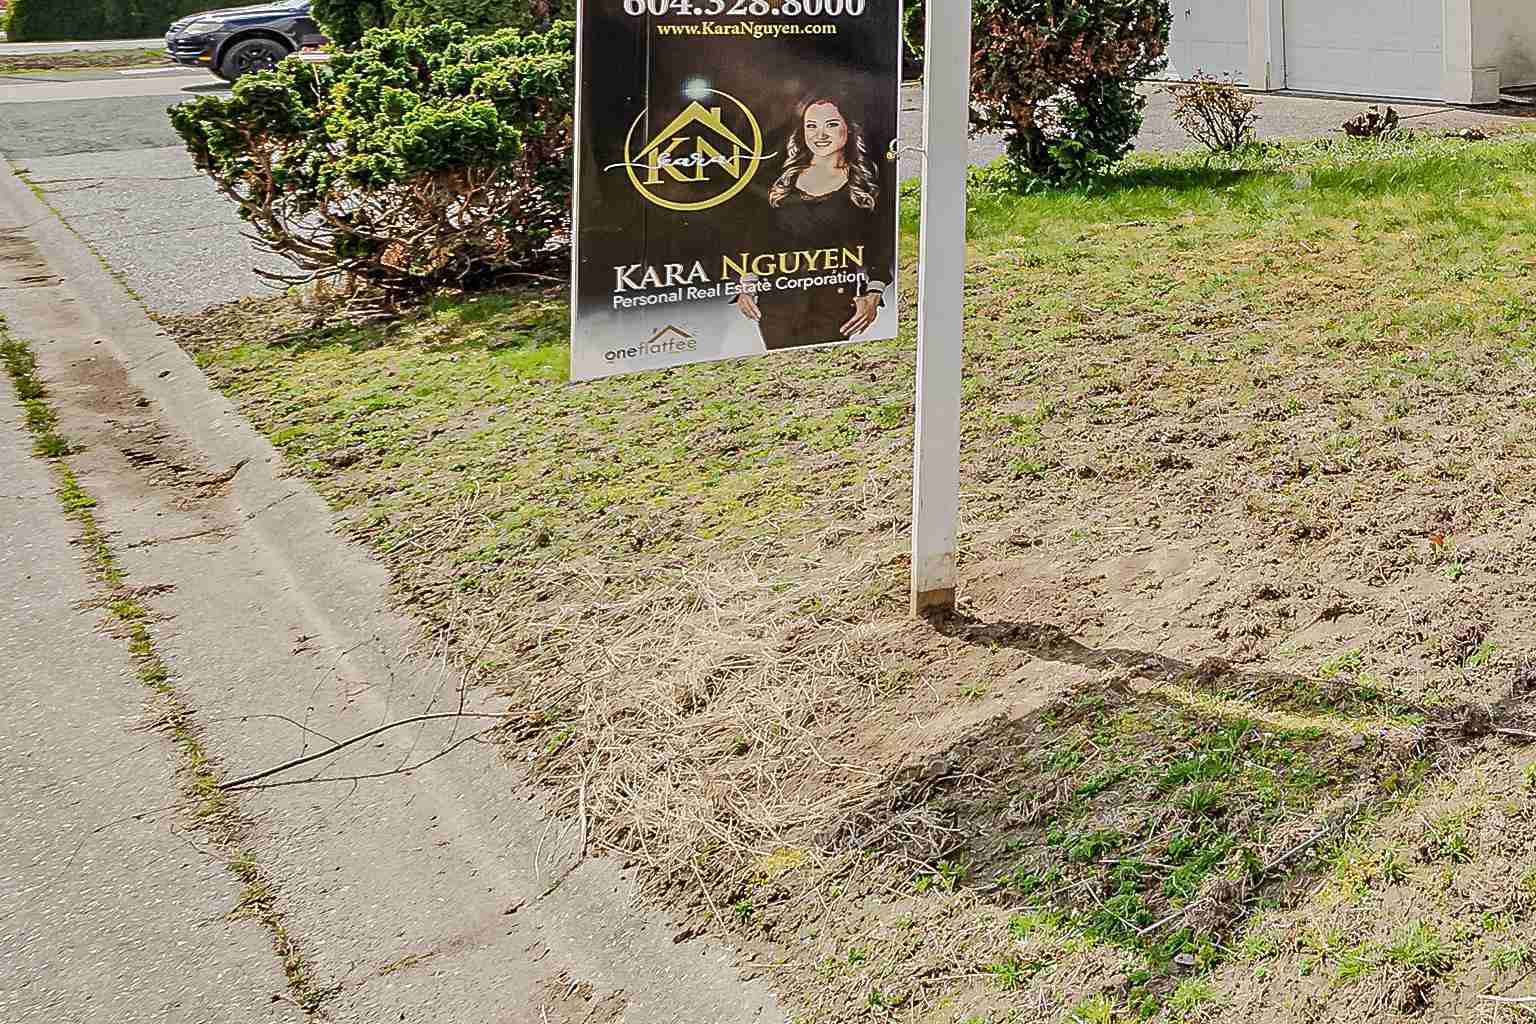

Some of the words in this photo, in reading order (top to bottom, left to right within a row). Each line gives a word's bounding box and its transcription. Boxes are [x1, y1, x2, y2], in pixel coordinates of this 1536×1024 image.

[656, 21, 837, 39] www.KaraNguyen.com
[613, 260, 710, 293] KARA
[720, 245, 865, 280] NGUYEN
[612, 290, 683, 310] Personal
[686, 285, 720, 301] Real
[724, 280, 772, 296] Estate
[775, 271, 866, 291] Corporation
